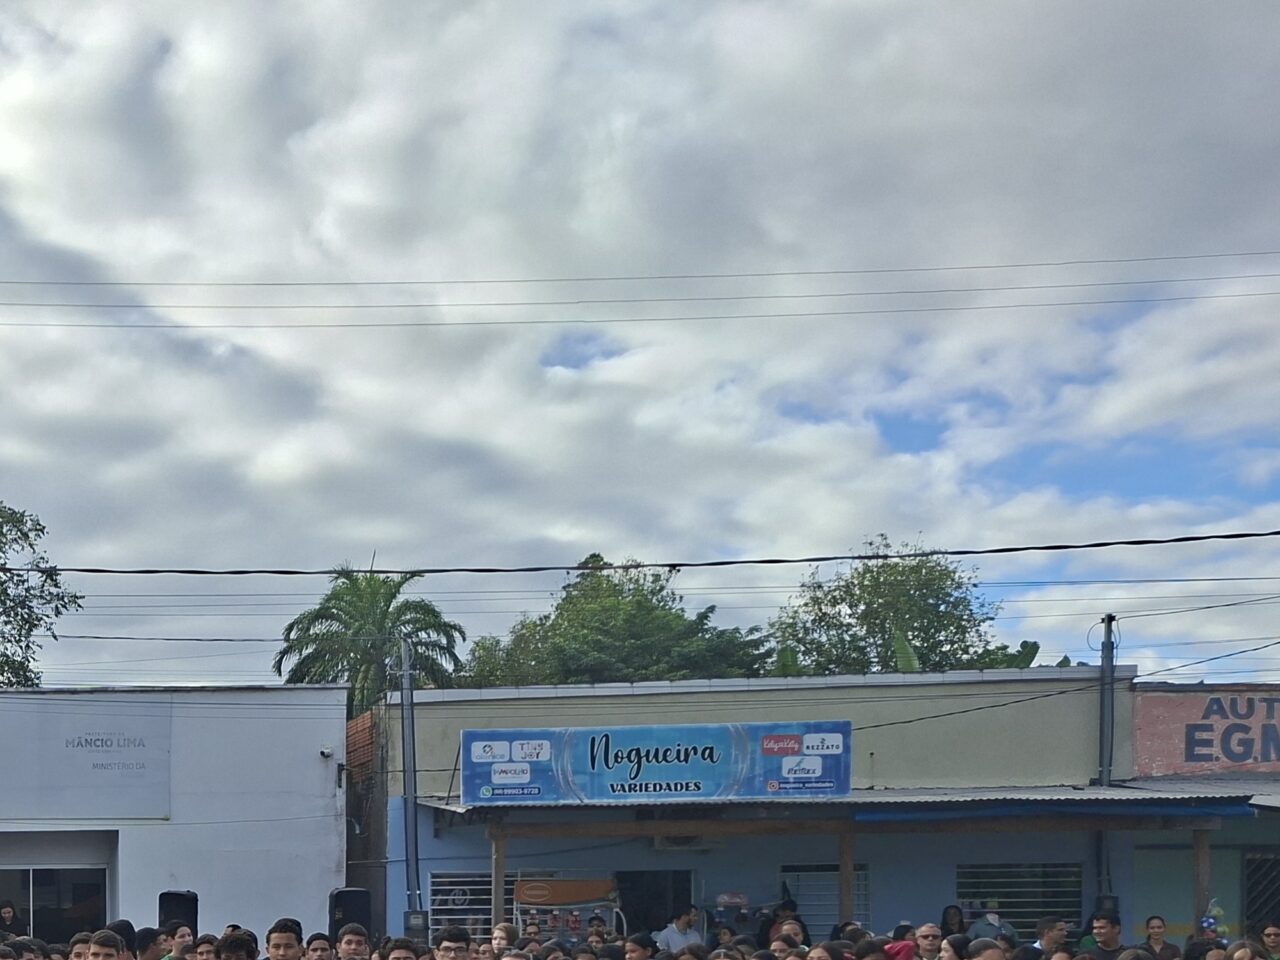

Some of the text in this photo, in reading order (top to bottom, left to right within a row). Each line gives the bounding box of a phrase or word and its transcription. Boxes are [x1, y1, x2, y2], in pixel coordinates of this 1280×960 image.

[1201, 697, 1280, 720] AUT
[117, 738, 146, 748] LIMA
[590, 733, 721, 780] Nogueira
[609, 781, 702, 793] VARIEDADES
